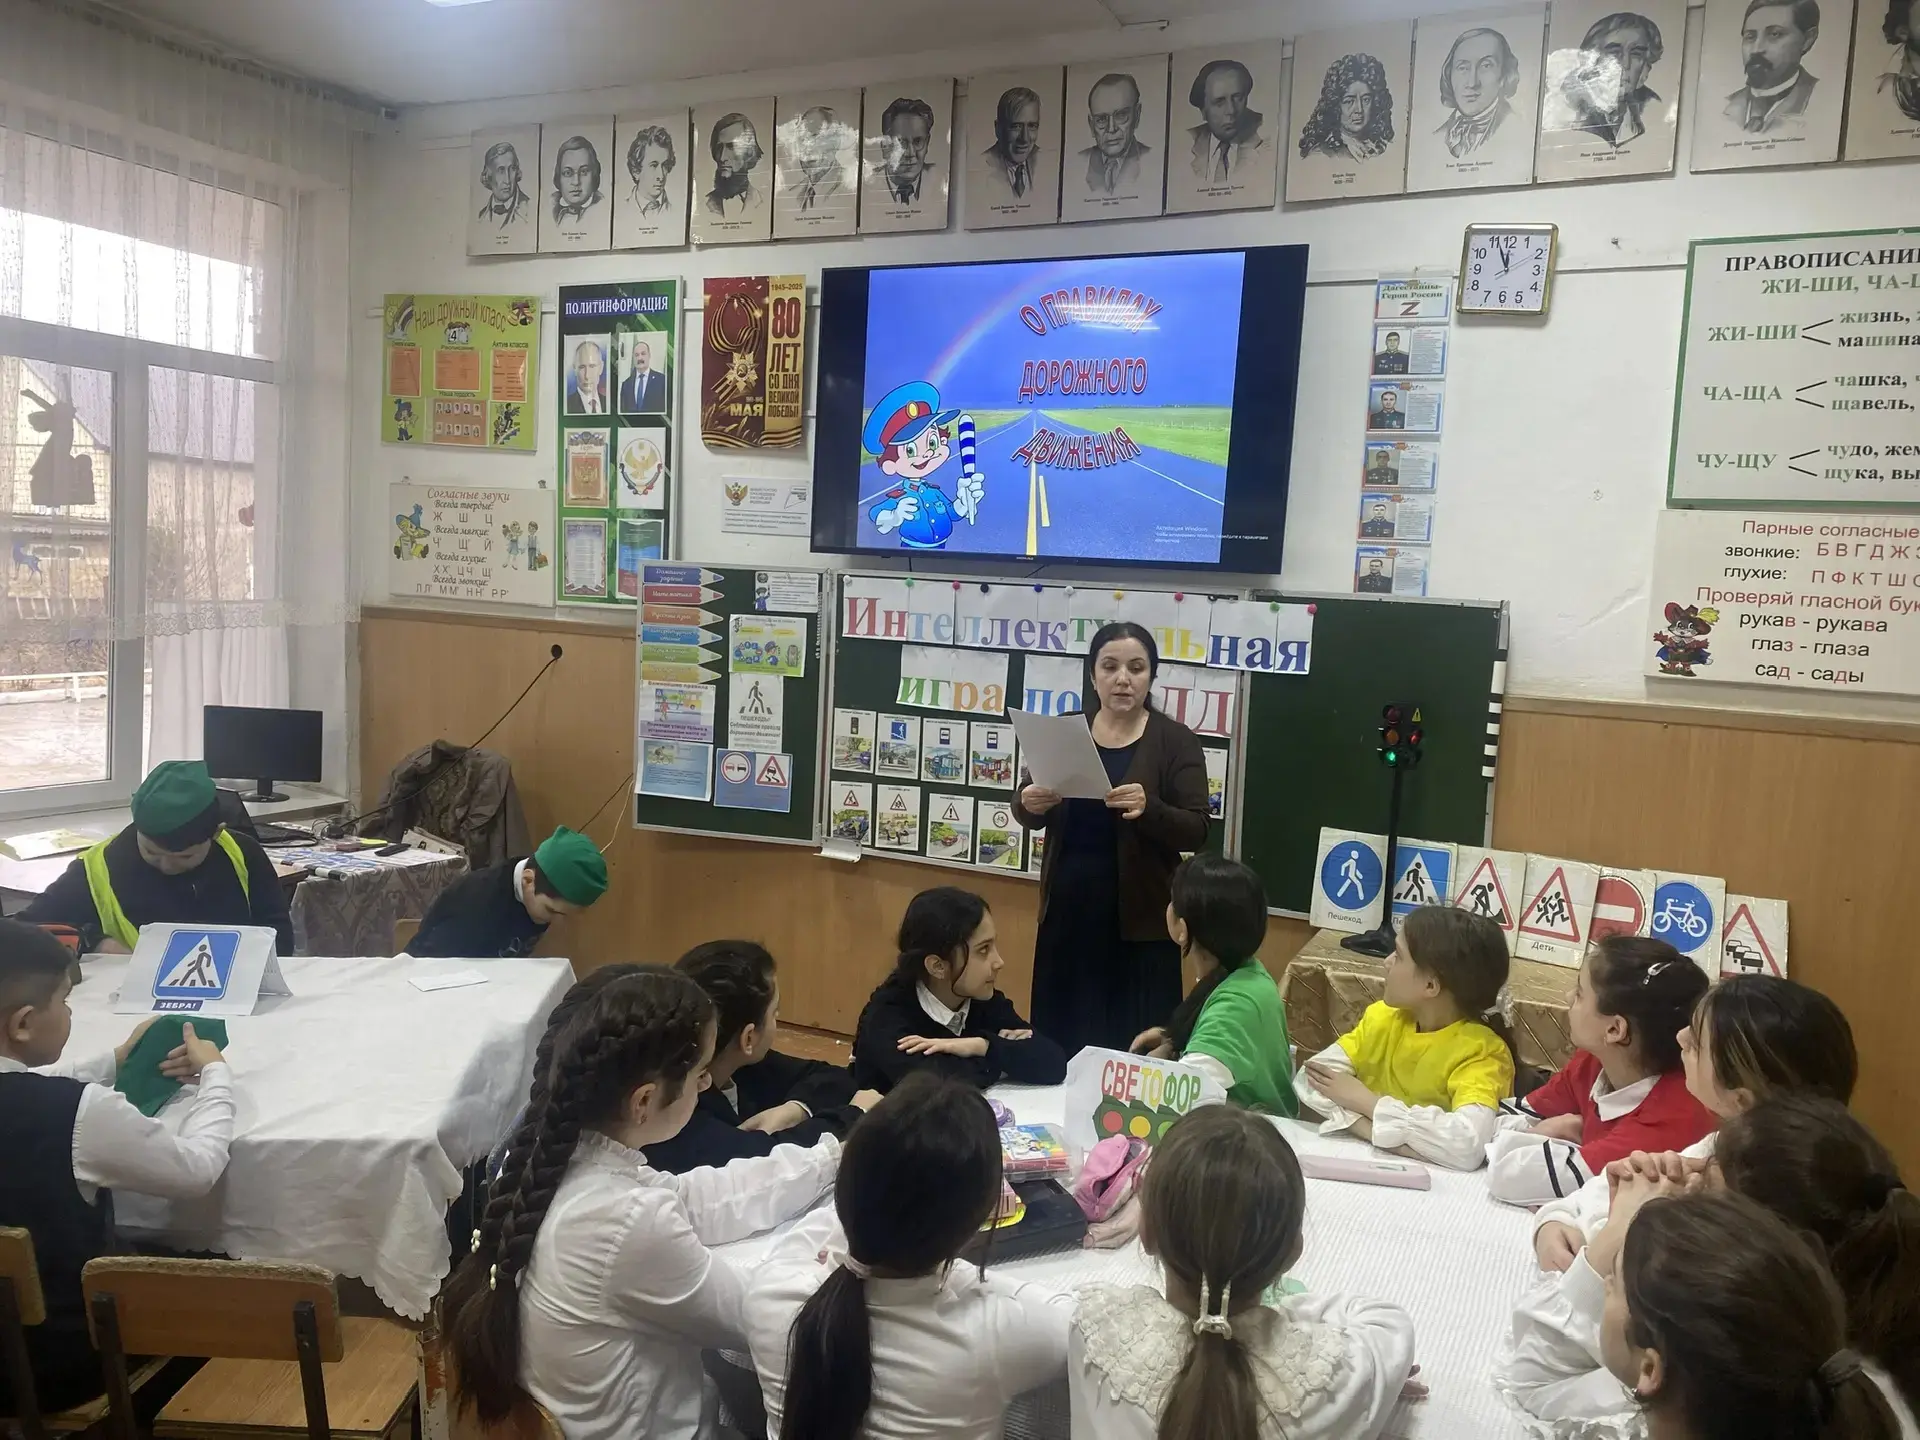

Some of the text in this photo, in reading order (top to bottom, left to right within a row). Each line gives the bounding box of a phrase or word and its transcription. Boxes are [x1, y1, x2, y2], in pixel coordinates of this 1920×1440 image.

[1489, 236, 1500, 248] 11
[1504, 236, 1518, 248] 12
[1524, 236, 1530, 248] 1
[1474, 248, 1487, 260] 10
[1534, 248, 1544, 260] 2
[1725, 248, 1920, 272] ПРАВОПИСАНИ
[1474, 264, 1482, 274] 9
[1532, 265, 1541, 276] 3
[1471, 280, 1480, 291] 8
[1530, 282, 1538, 292] 4
[1762, 276, 1859, 294] ЖИ-ШИ,
[1484, 290, 1492, 303] 7
[1498, 291, 1507, 304] 6
[1514, 291, 1524, 304] 5
[565, 296, 668, 314] ПОЛИТИНФОРМАЦИЯ
[1020, 285, 1163, 335] О ПРАВИЛАХ
[1400, 302, 1420, 316] Z
[414, 300, 506, 332] Наш дружный класс
[772, 297, 801, 338] 80
[1840, 310, 1910, 324] жизнь,
[450, 330, 457, 341] 4
[1708, 324, 1798, 342] ЖИ-ШИ
[769, 344, 800, 372] ЛЕТ
[769, 374, 799, 390] СО ДНЯ
[1018, 357, 1148, 402] ДОРОЖНОГО
[1834, 374, 1908, 388] чашка,
[768, 390, 800, 404] ВЕЛИКОЙ
[1704, 385, 1782, 403] ЧА-ЩА
[730, 403, 764, 416] МАЯ
[1832, 398, 1915, 412] щавель,
[1010, 426, 1142, 469] ДВИЖЕНИЯ
[1827, 444, 1879, 460] чудо,
[1697, 454, 1778, 471] ЧУ-ЩУ
[1824, 466, 1884, 482] щука,
[428, 488, 510, 504] Согласные звуки
[434, 499, 459, 510] Всегда
[433, 512, 494, 526] Ж Ш Ц
[434, 525, 459, 535] Всегда
[1742, 520, 1920, 538] Парные согласные
[435, 552, 459, 562] Всегда
[1724, 542, 1910, 560] звонкие: Б В Г Д Ж
[432, 574, 457, 584] Всегда
[1724, 566, 1787, 581] глухие:
[1812, 570, 1825, 584] П
[1832, 570, 1846, 584] Ф
[1852, 572, 1864, 585] К
[1870, 572, 1882, 586] Т
[1888, 573, 1906, 586] Ш
[1697, 587, 1794, 608] Проверяй
[1800, 594, 1882, 610] гласной
[1740, 612, 1796, 628] рукав
[1816, 617, 1888, 634] рукава
[845, 596, 1310, 672] Интеллектльная
[1752, 637, 1793, 652] глаз
[1814, 642, 1870, 656] глаза
[1755, 664, 1790, 680] сад
[1812, 667, 1864, 684] сады
[899, 677, 1003, 713] игра
[1024, 688, 1082, 716] по
[1328, 912, 1362, 924] Пешеход
[1531, 942, 1556, 952] Дети.
[1101, 1060, 1201, 1112] СВЕТОФОР
